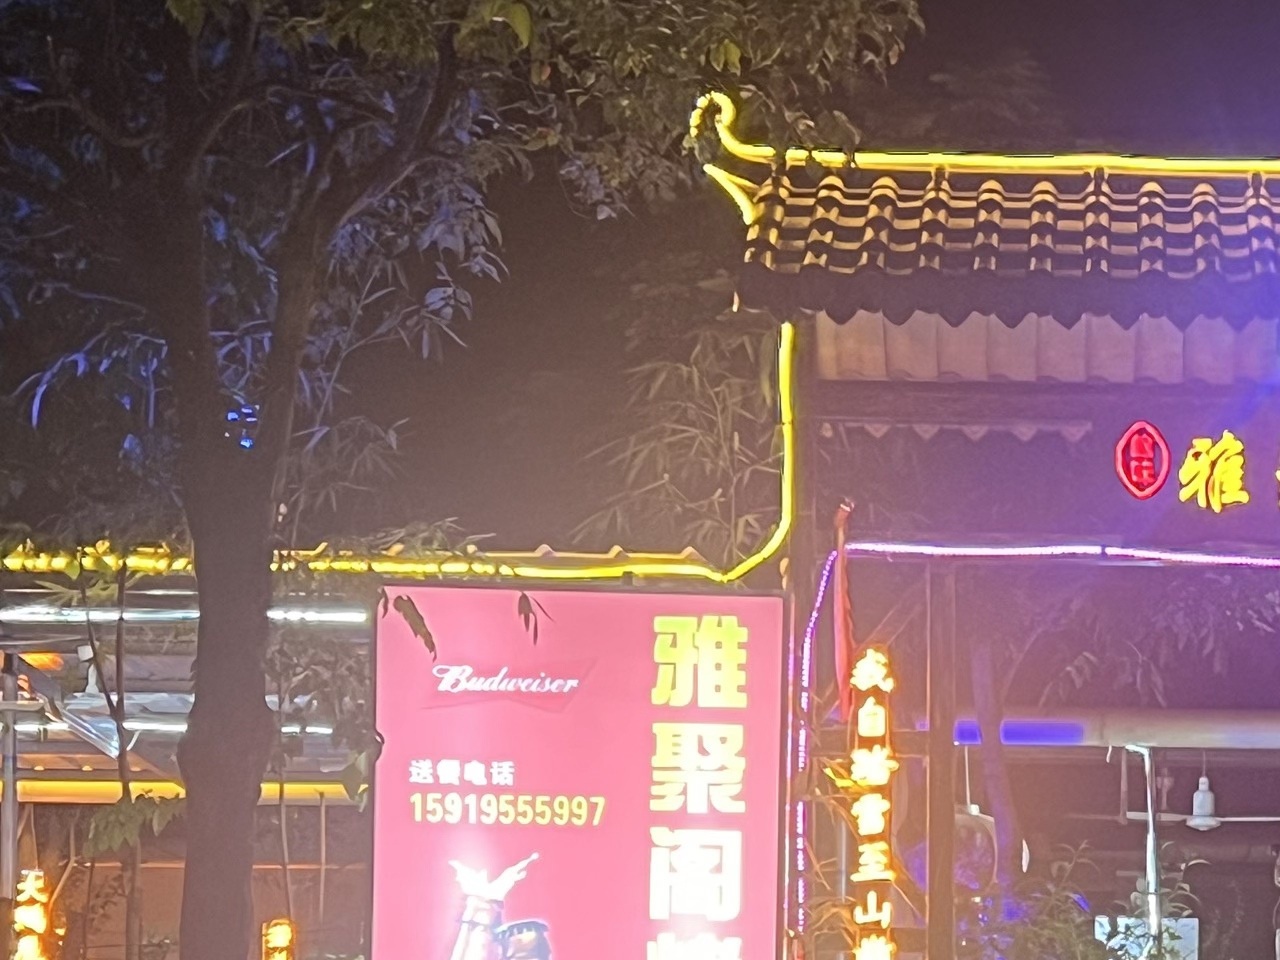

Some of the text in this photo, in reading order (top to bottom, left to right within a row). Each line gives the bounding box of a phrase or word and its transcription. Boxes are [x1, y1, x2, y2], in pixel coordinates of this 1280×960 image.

[432, 664, 580, 694] Budweiser
[408, 758, 516, 787] 送餐电话
[409, 791, 606, 827] 15919555997
